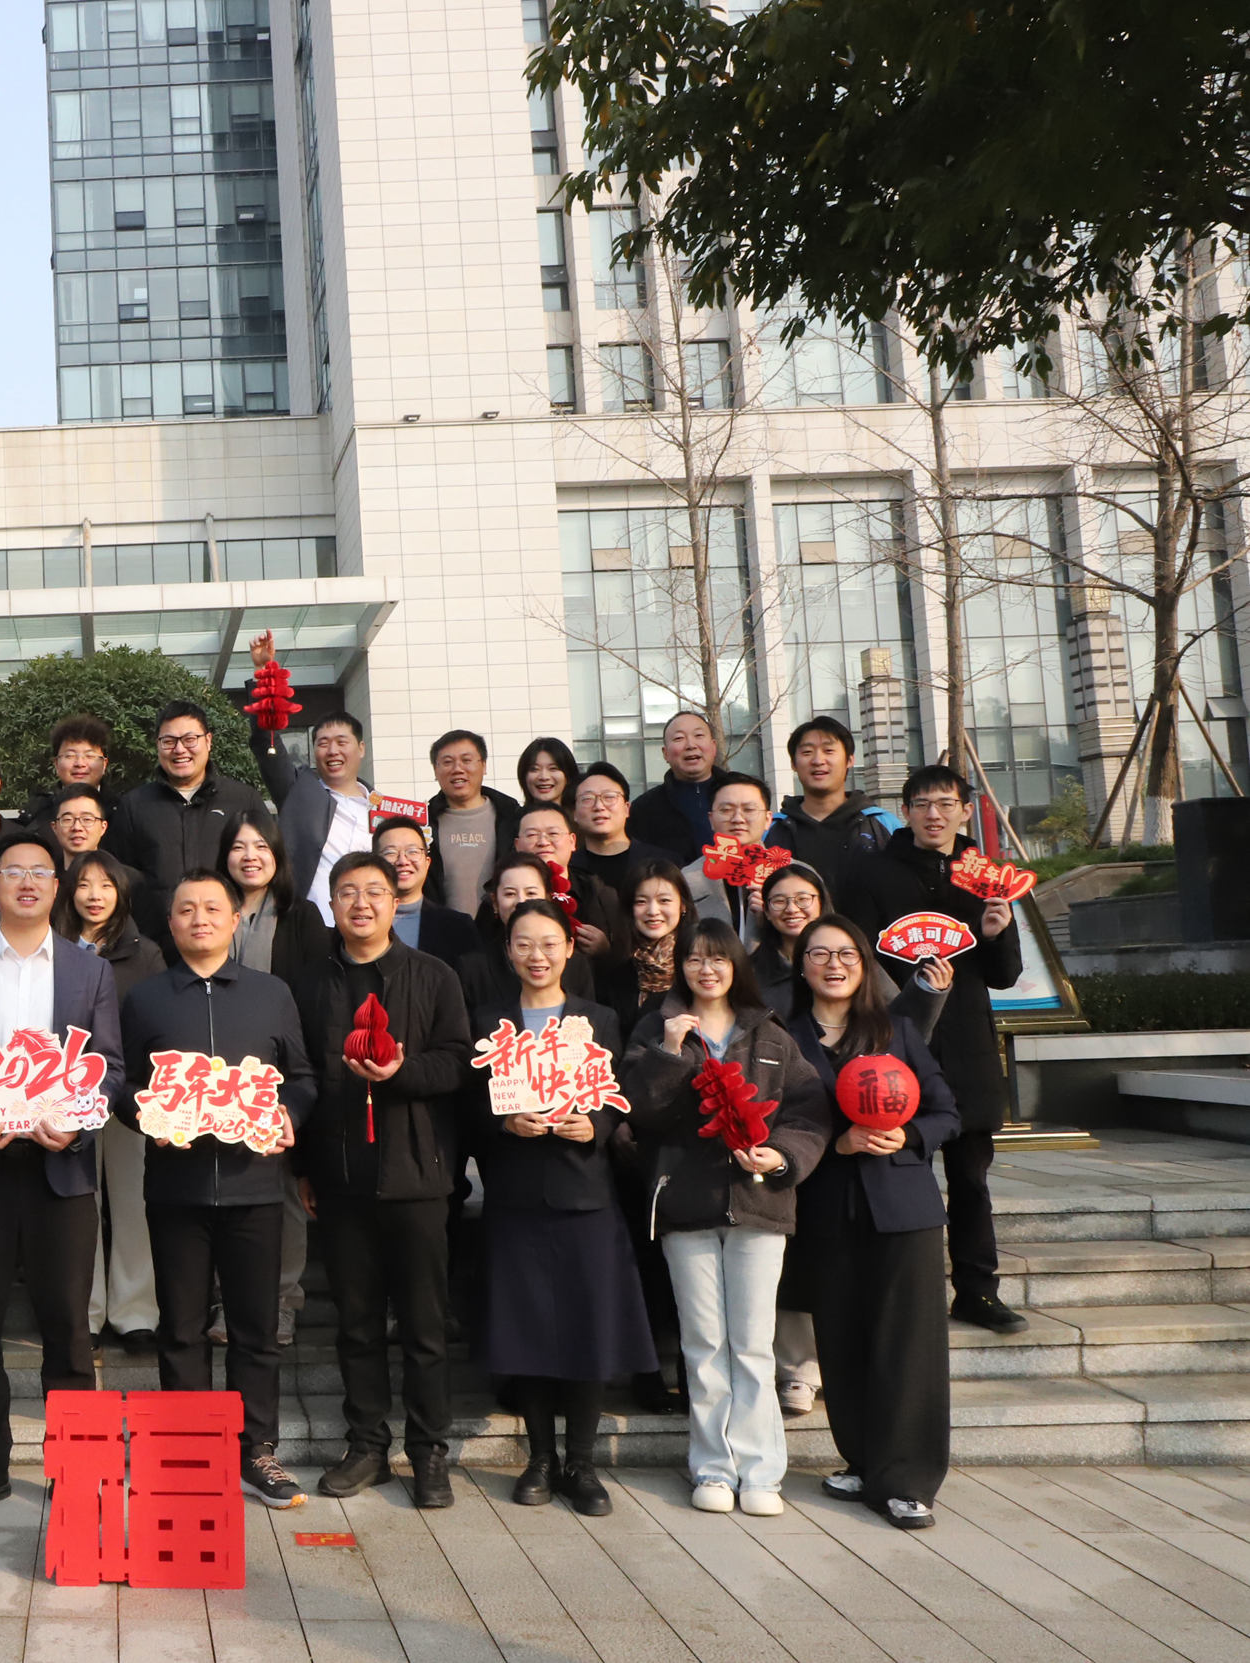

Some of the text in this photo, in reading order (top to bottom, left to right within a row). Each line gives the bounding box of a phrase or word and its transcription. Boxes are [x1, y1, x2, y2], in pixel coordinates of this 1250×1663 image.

[953, 849, 1001, 884] 新年
[888, 926, 963, 953] 未来可期
[136, 1052, 283, 1126] 馬年大吉
[492, 1078, 526, 1089] HAPPY
[493, 1091, 517, 1100] NEW
[858, 1068, 909, 1116] 福
[494, 1103, 522, 1112] YEAR
